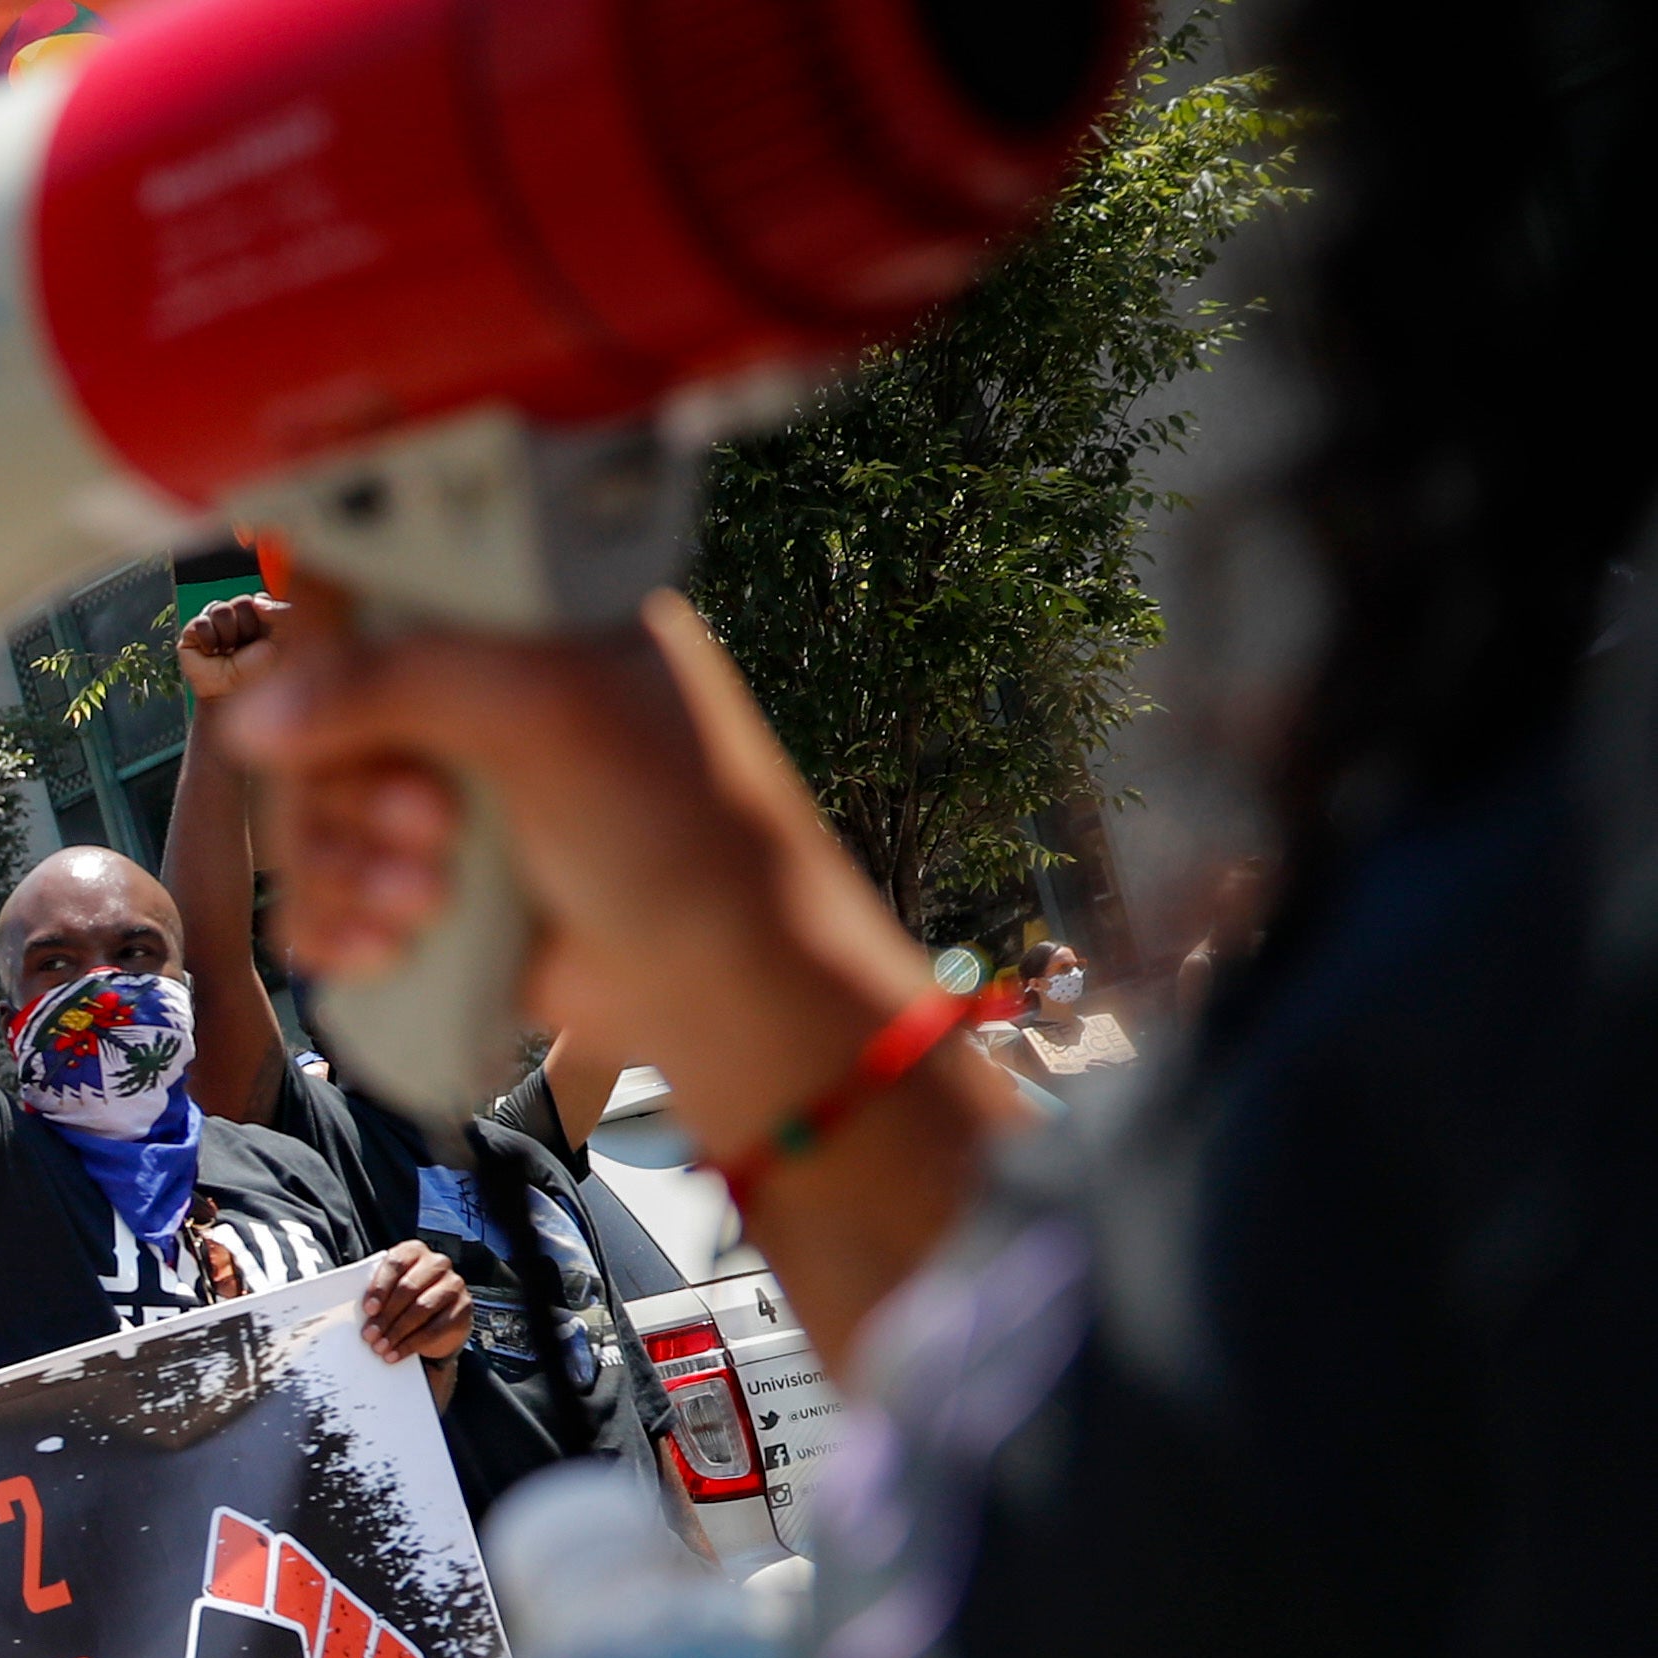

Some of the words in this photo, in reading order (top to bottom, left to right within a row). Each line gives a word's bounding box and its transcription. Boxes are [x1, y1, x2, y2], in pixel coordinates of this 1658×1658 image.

[754, 1287, 778, 1324] 4
[747, 1370, 827, 1396] Univision
[787, 1402, 843, 1424] @UNIVIS
